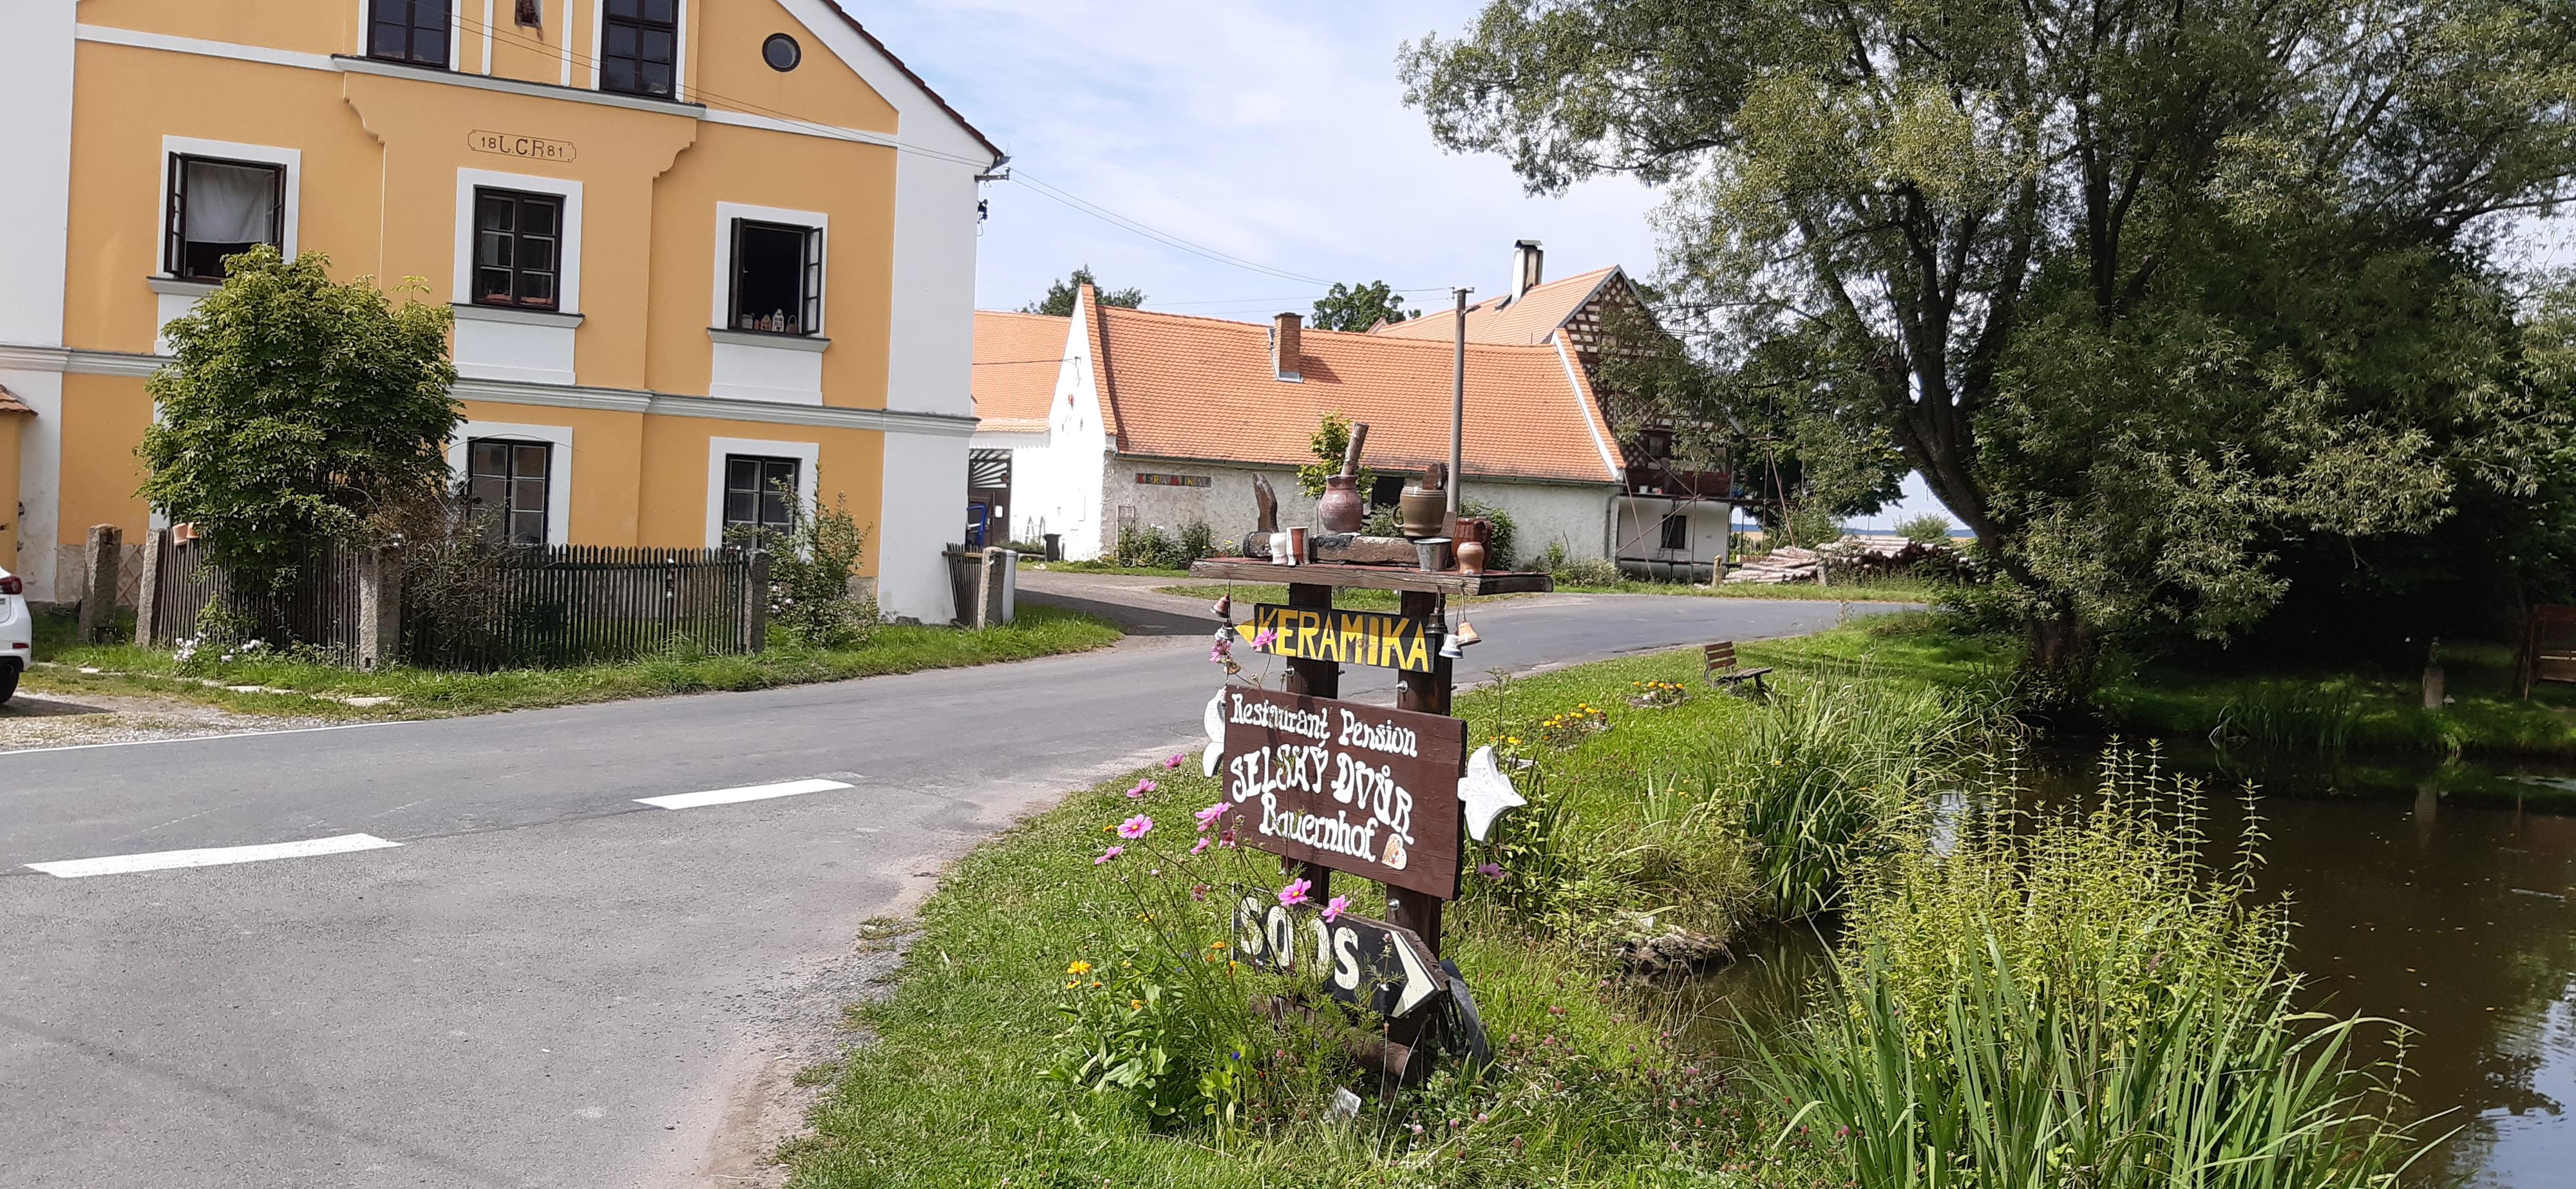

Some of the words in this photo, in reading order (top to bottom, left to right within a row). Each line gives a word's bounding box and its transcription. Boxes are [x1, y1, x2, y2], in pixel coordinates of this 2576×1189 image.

[1256, 607, 1429, 673] KERAMIKA
[1229, 693, 1331, 739] Restaurant
[1338, 708, 1418, 757] Pension
[1230, 739, 1329, 803] SELSKÝ
[1259, 792, 1378, 863] Bauernhof
